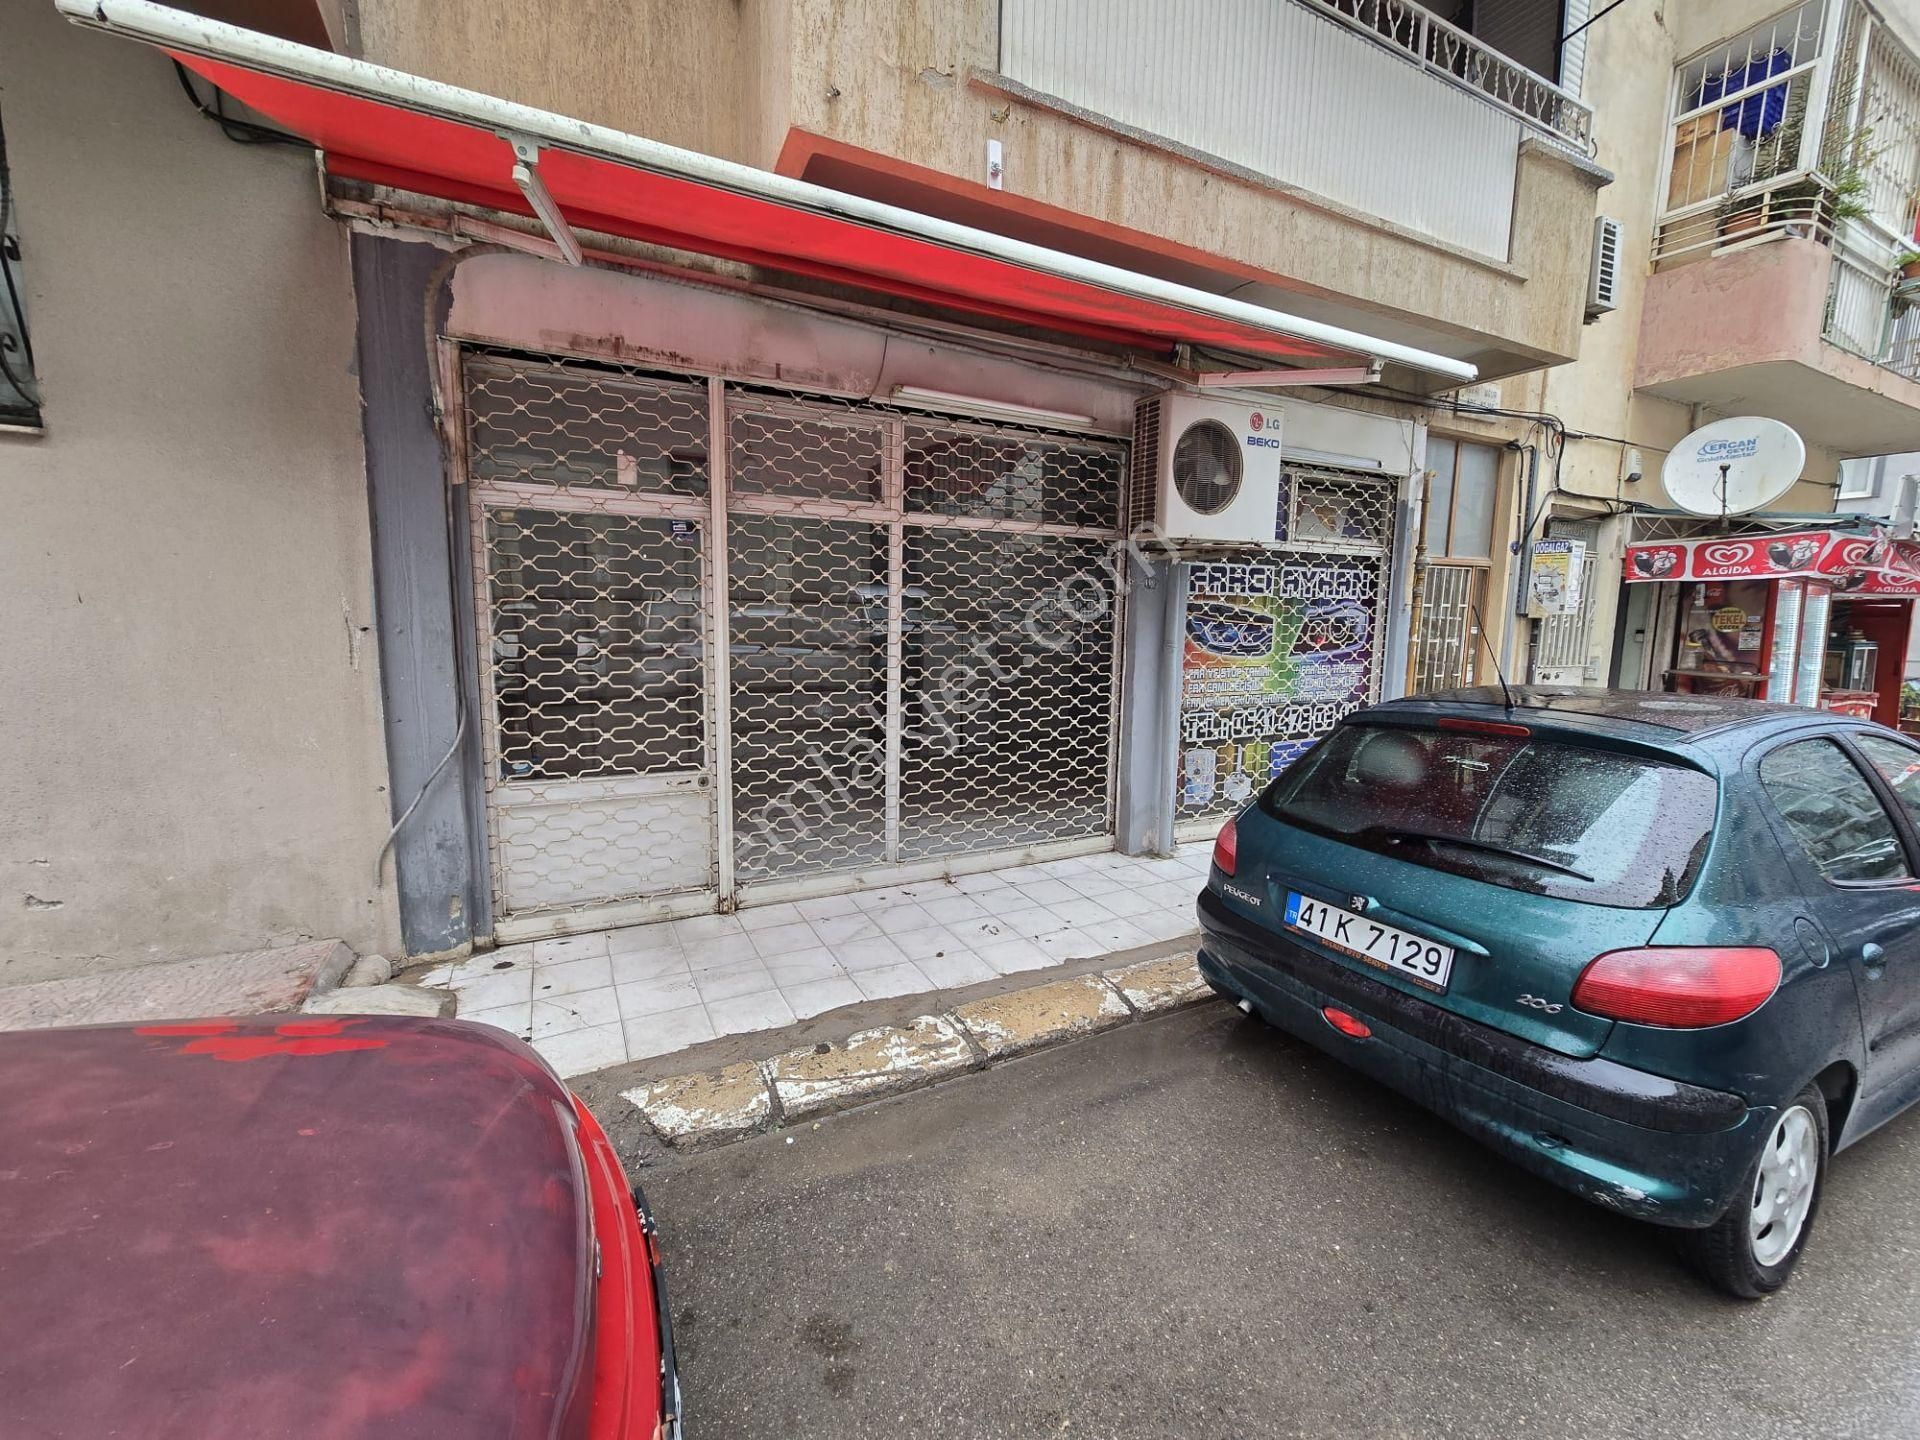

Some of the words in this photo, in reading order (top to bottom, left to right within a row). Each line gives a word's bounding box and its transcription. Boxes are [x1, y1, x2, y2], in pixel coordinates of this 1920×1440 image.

[1266, 417, 1280, 430] LG
[1247, 435, 1280, 449] BEKO
[1709, 439, 1757, 451] ERCAN
[1702, 565, 1752, 576] ALGIDA
[1279, 566, 1370, 599] AYHAN
[1714, 614, 1746, 625] TEKEL
[1223, 883, 1262, 906] PEUGEOT
[1289, 909, 1298, 920] TR
[1300, 902, 1328, 932] 41
[1334, 913, 1355, 943] K
[1366, 924, 1443, 976] 7129
[1346, 948, 1362, 959] OTO
[1515, 993, 1564, 1014] 206
